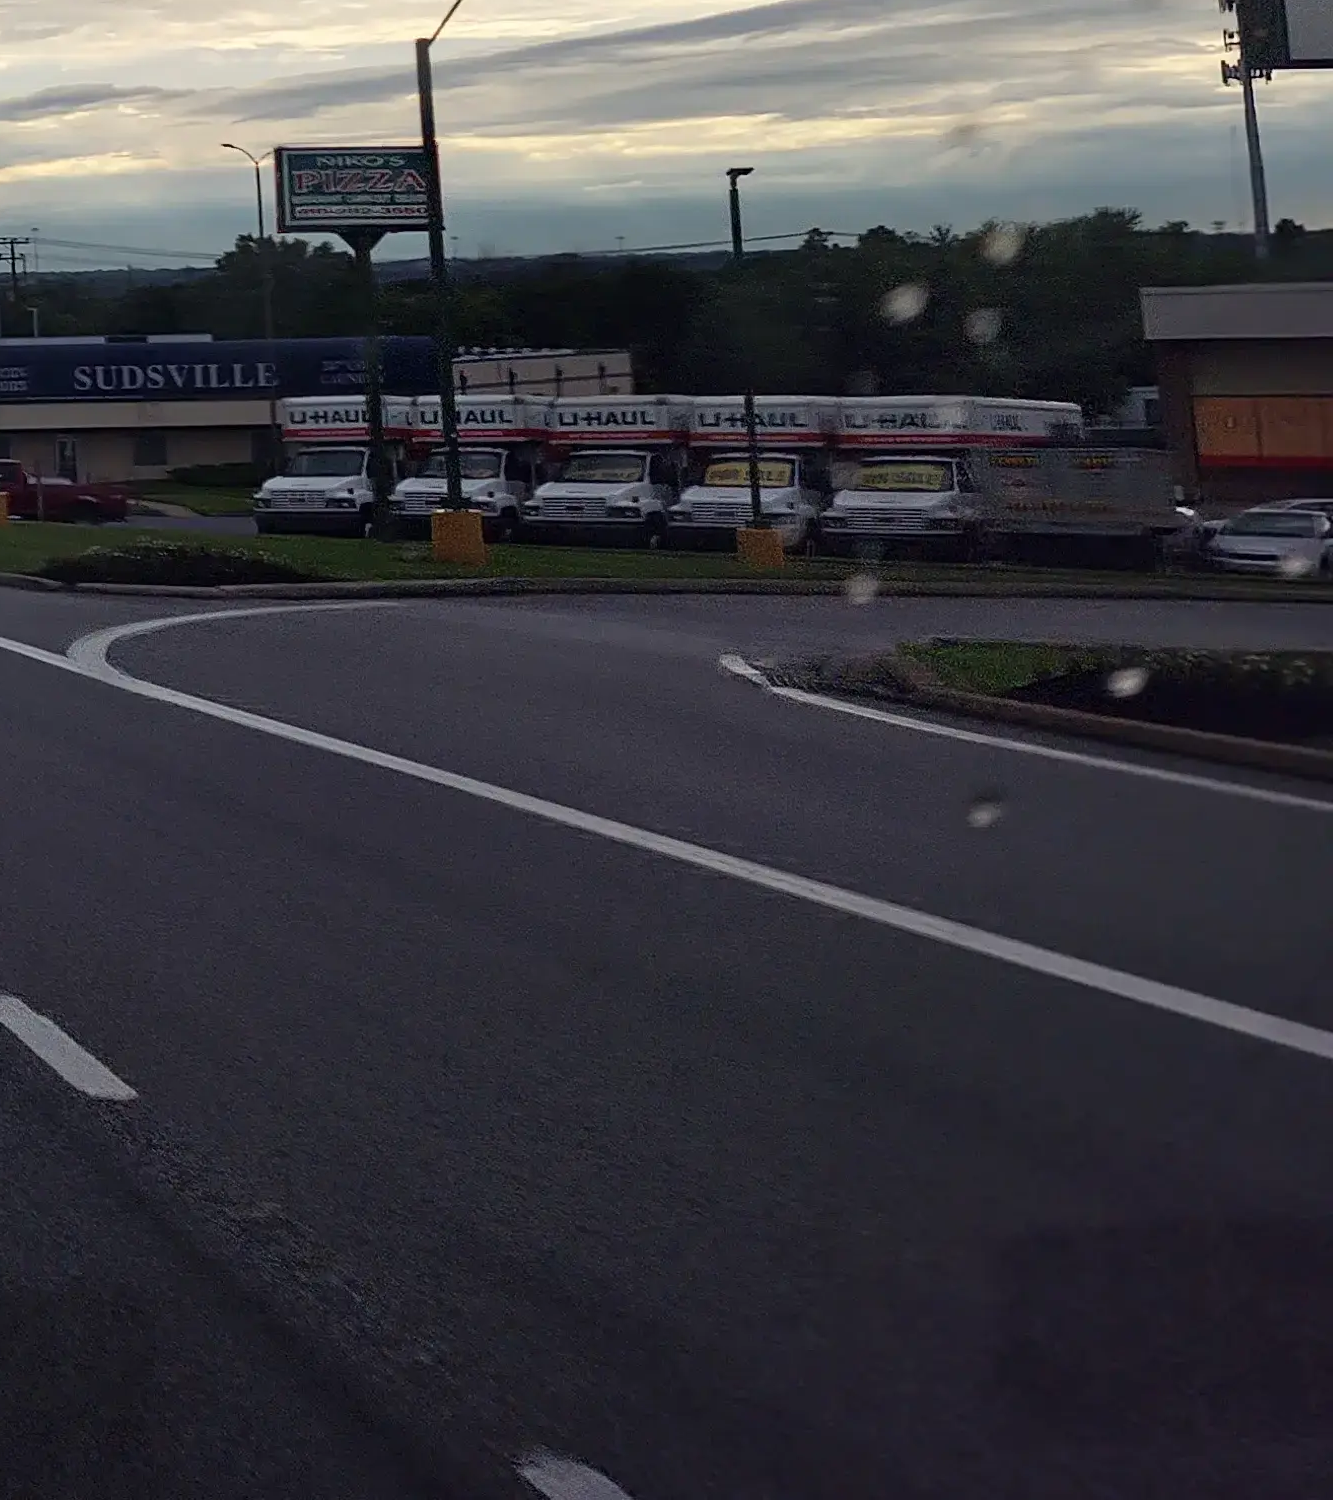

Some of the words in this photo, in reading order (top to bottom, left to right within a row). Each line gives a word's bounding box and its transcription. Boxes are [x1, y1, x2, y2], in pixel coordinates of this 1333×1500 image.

[292, 168, 427, 193] PIZZA
[73, 362, 278, 390] SUDSVILLE
[558, 411, 655, 426] U-HAUL
